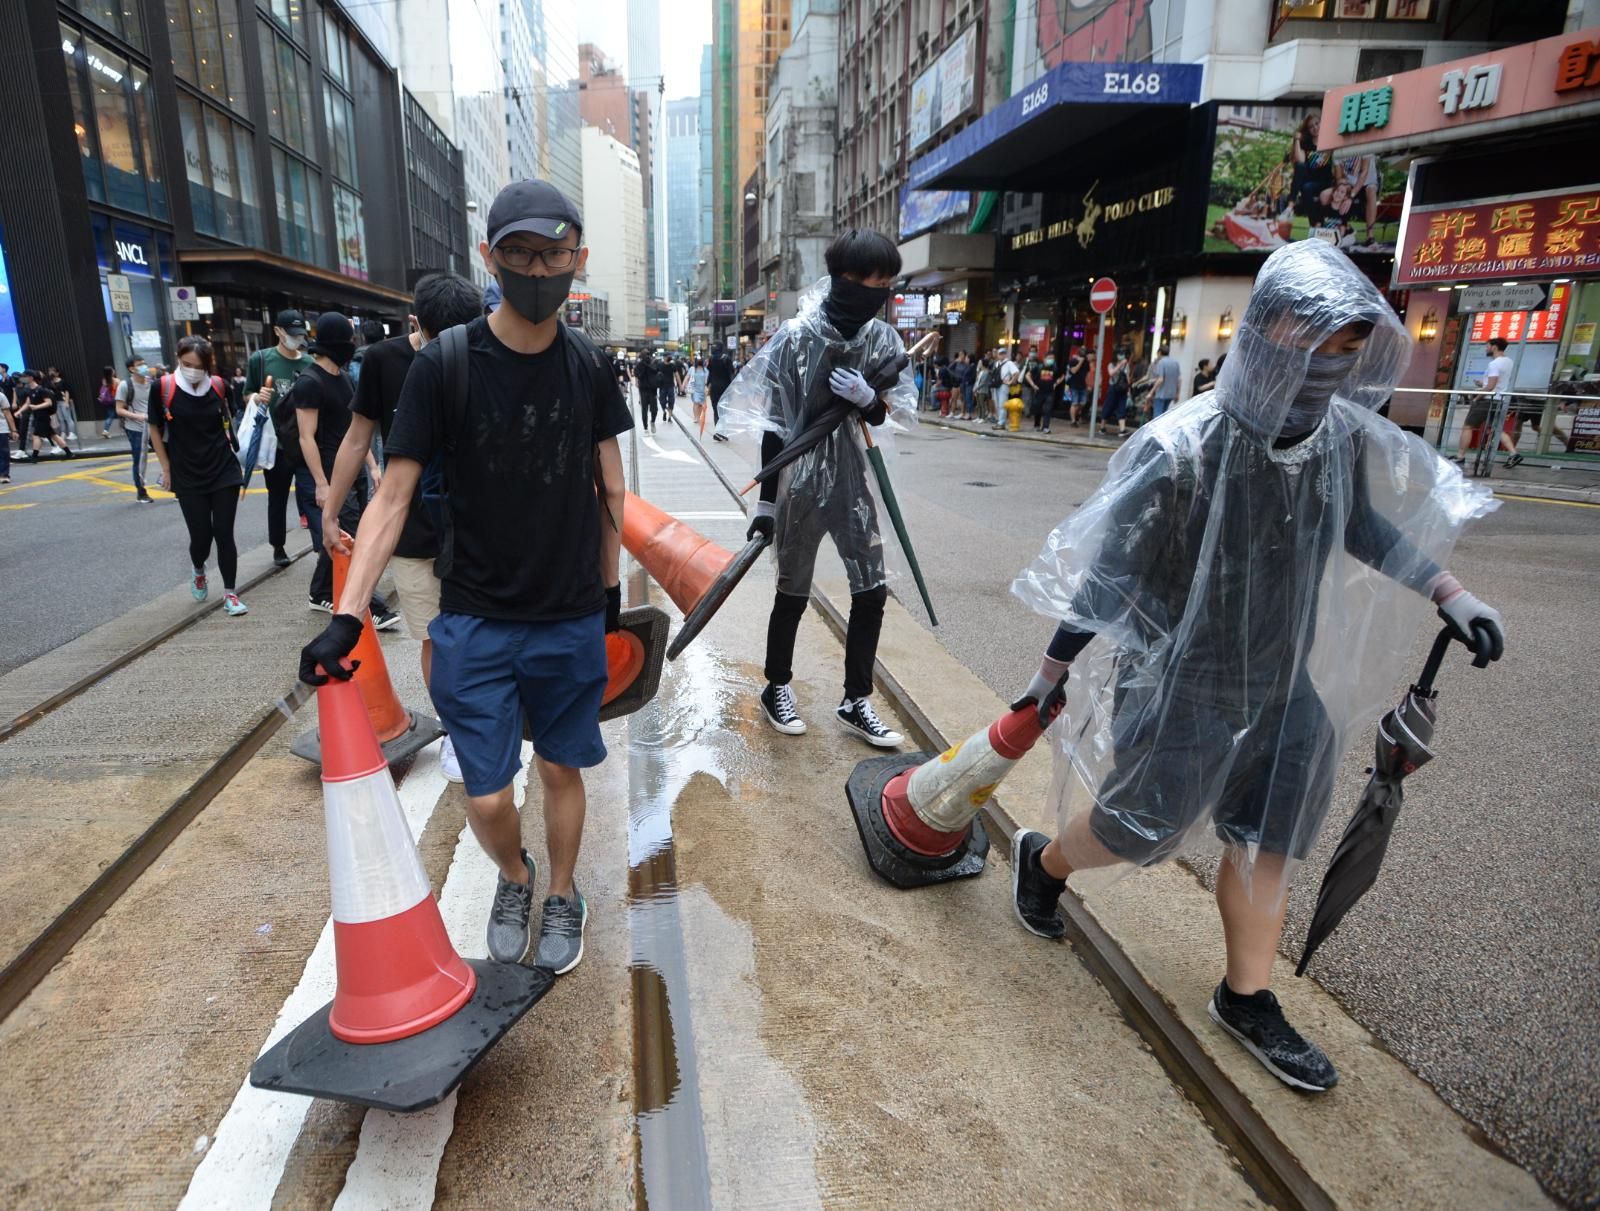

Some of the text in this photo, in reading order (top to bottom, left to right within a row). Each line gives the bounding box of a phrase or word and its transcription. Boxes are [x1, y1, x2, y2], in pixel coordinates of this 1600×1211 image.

[1104, 73, 1160, 94] E168
[1022, 83, 1048, 116] E168
[1012, 186, 1174, 250] BEVERLY HILLS POLO CLUB
[1413, 228, 1600, 265] 找換匯款
[1410, 264, 1458, 278] MONEY
[1459, 257, 1537, 275] EXCHANGE
[1539, 254, 1573, 269] AND
[1463, 289, 1485, 298] Wing
[1505, 287, 1534, 296] Street
